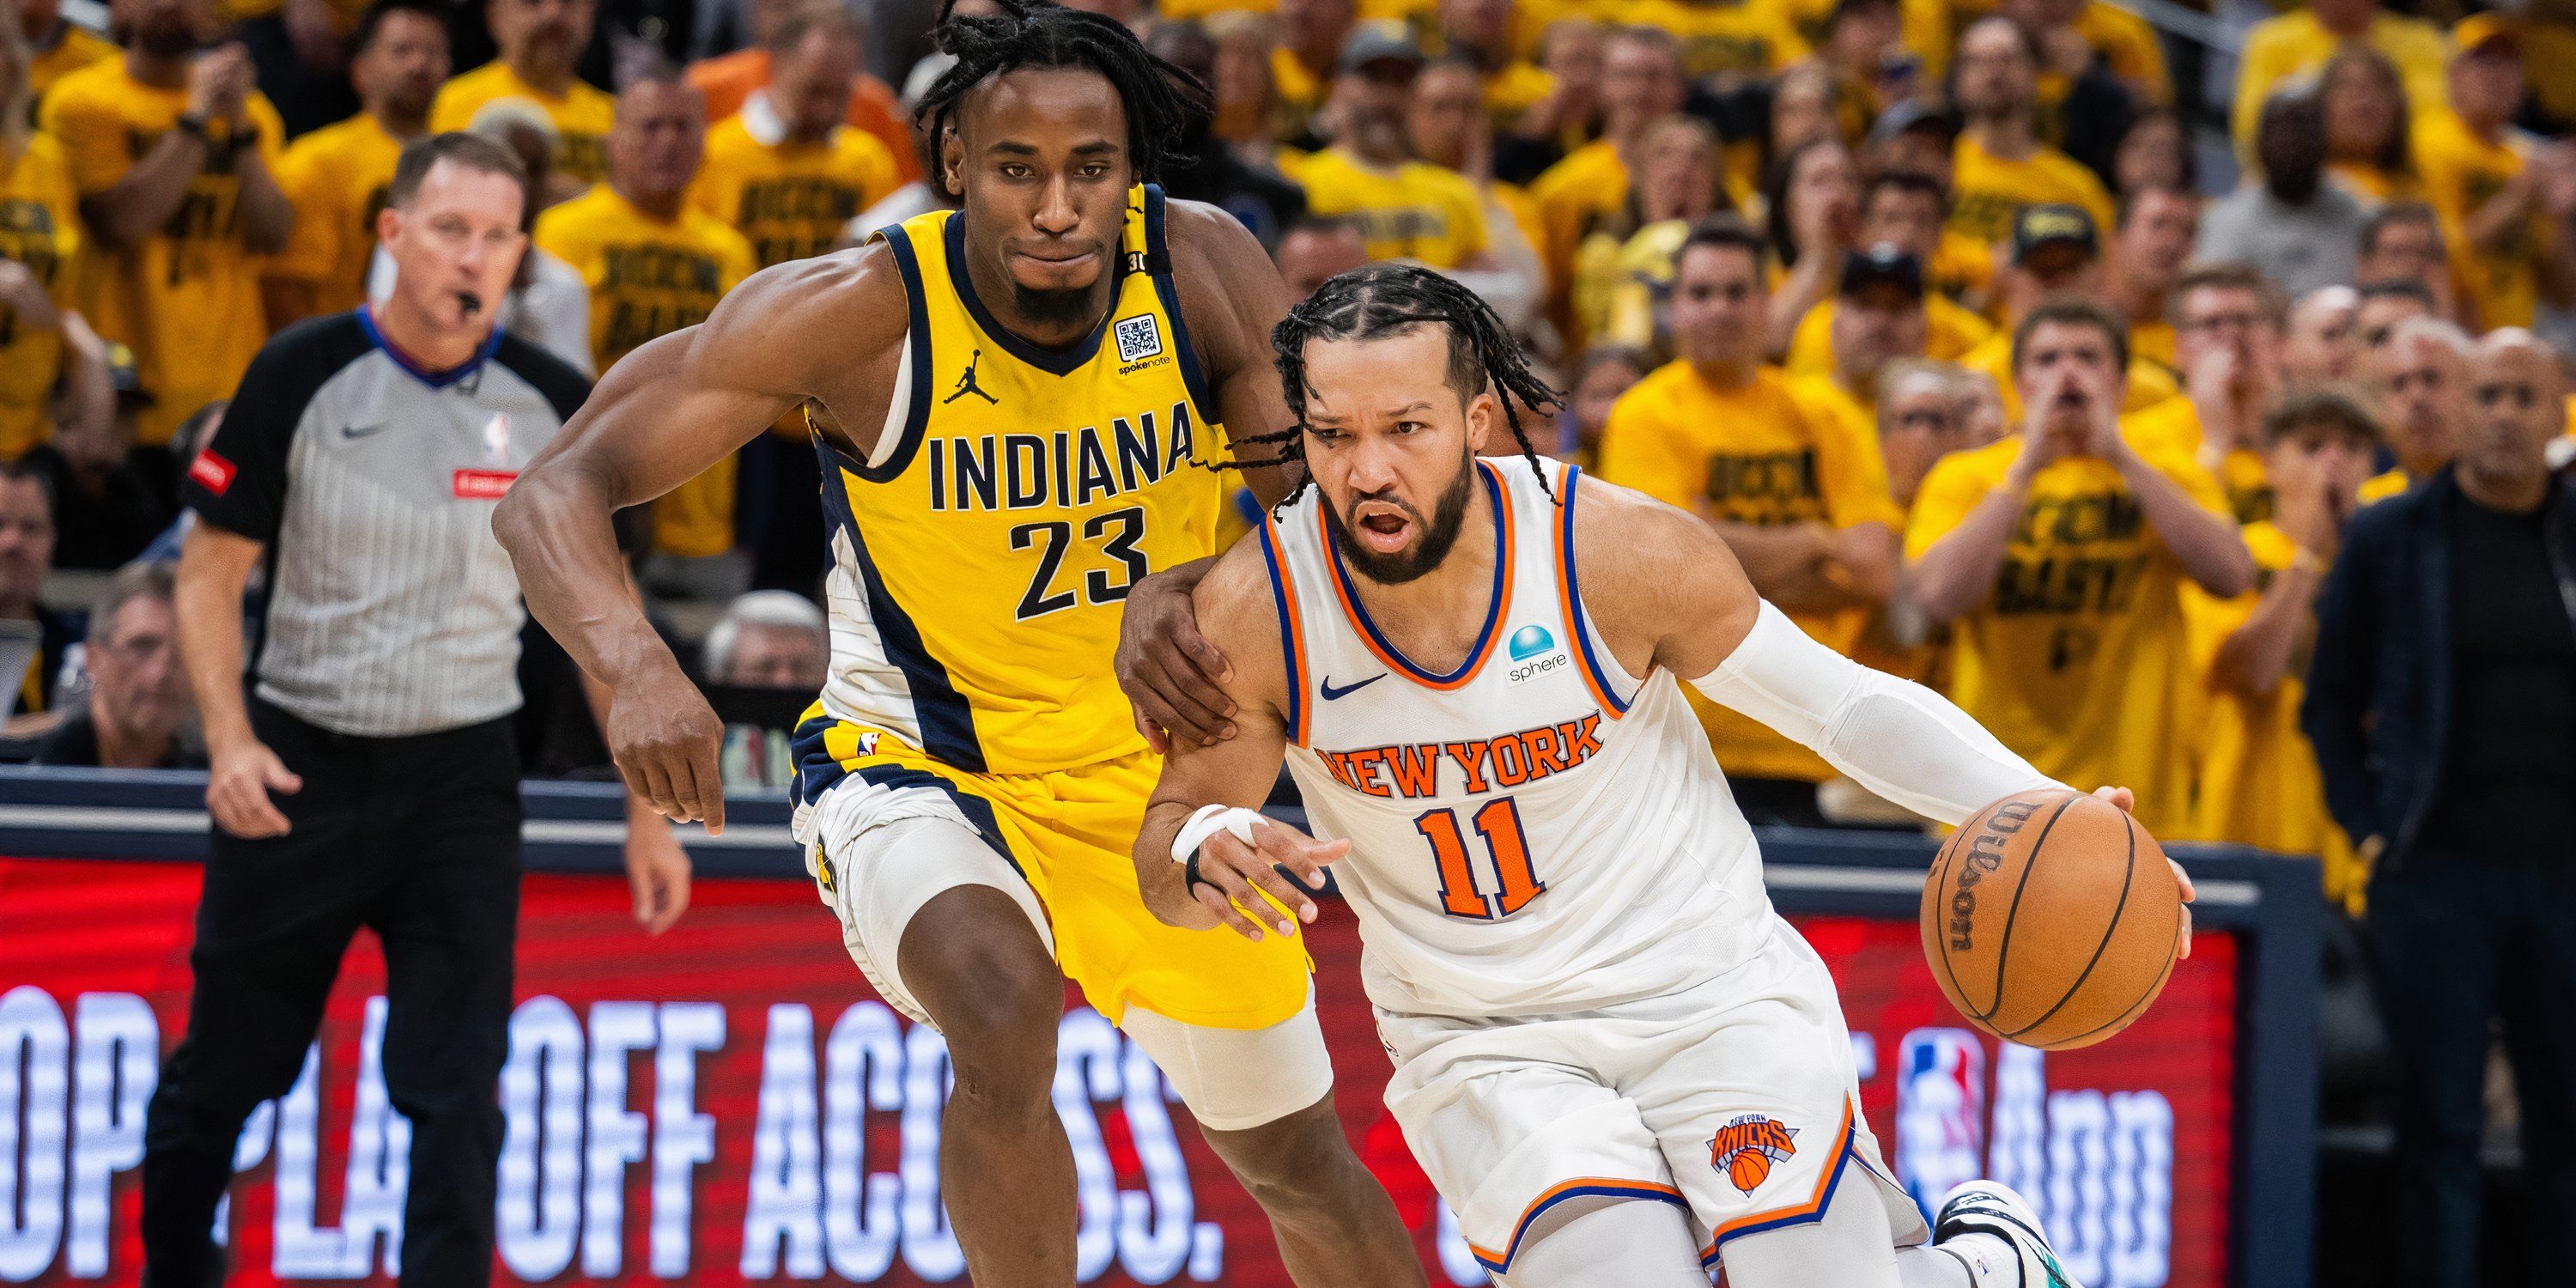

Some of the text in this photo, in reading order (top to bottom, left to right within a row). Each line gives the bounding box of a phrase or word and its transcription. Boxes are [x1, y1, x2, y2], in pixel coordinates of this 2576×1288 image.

[1118, 355, 1170, 376] spokenote
[928, 400, 1194, 513] INDIANA
[1008, 506, 1151, 624] 23
[1510, 653, 1567, 683] sphere
[1314, 708, 1607, 799] NEW YORK
[1413, 794, 1547, 920] 11
[1949, 801, 2044, 953] Wilson
[738, 999, 1224, 1284] ACCSS.
[1710, 1118, 1797, 1168] KNICKS
